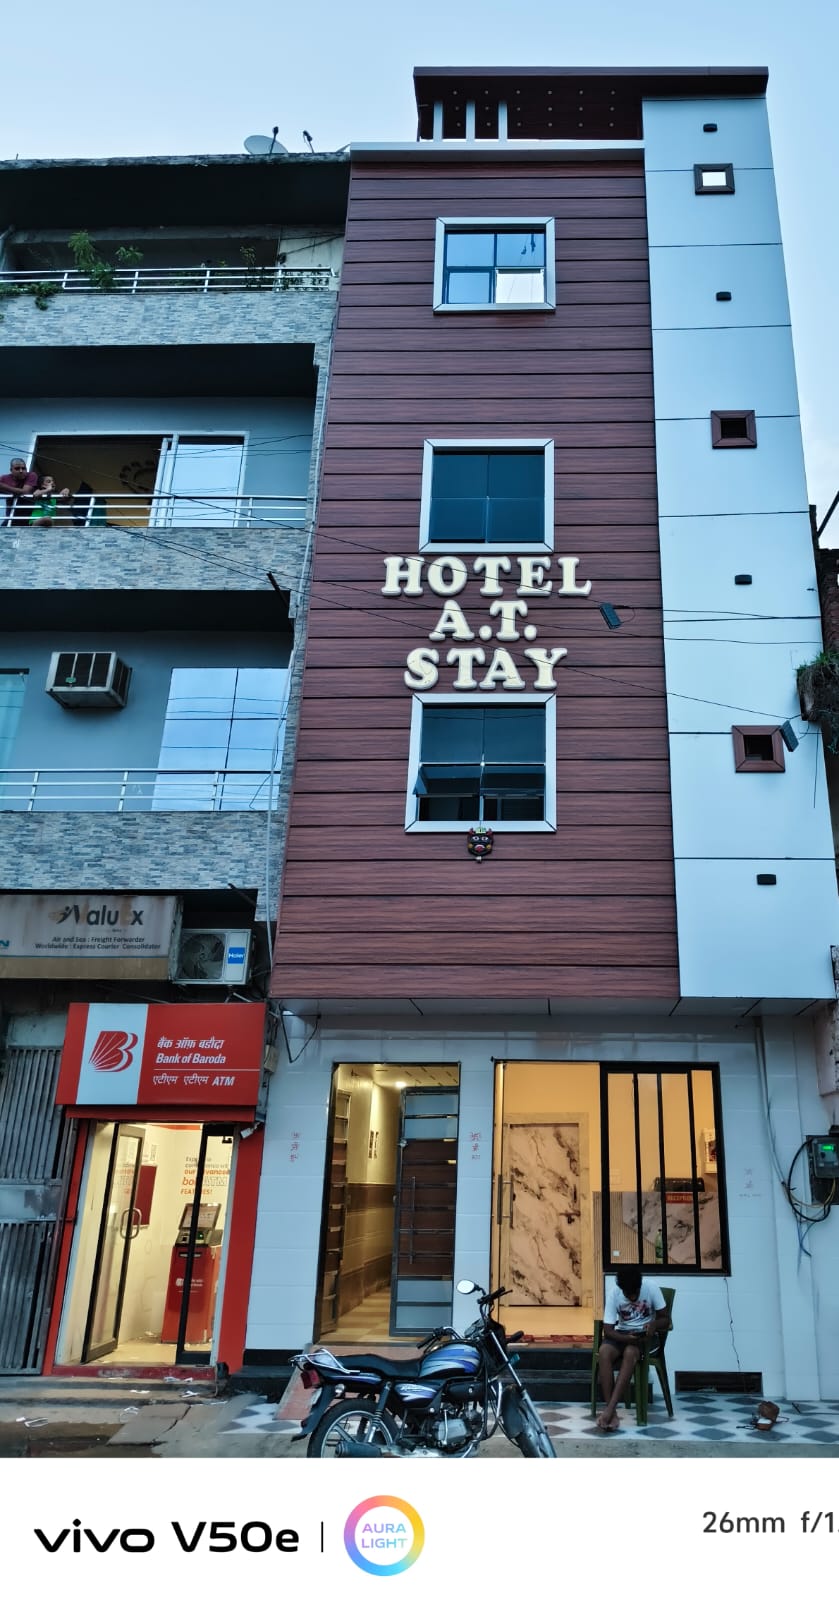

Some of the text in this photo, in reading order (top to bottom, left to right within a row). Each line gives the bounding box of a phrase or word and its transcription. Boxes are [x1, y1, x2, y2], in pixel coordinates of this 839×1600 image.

[381, 556, 592, 597] HOTEL
[428, 600, 538, 642] A.T.
[404, 647, 568, 691] STAY
[91, 936, 112, 945] Freight
[156, 1053, 226, 1064] Bank of Baroda
[153, 1073, 235, 1086] एटीएम एटीएम ATM
